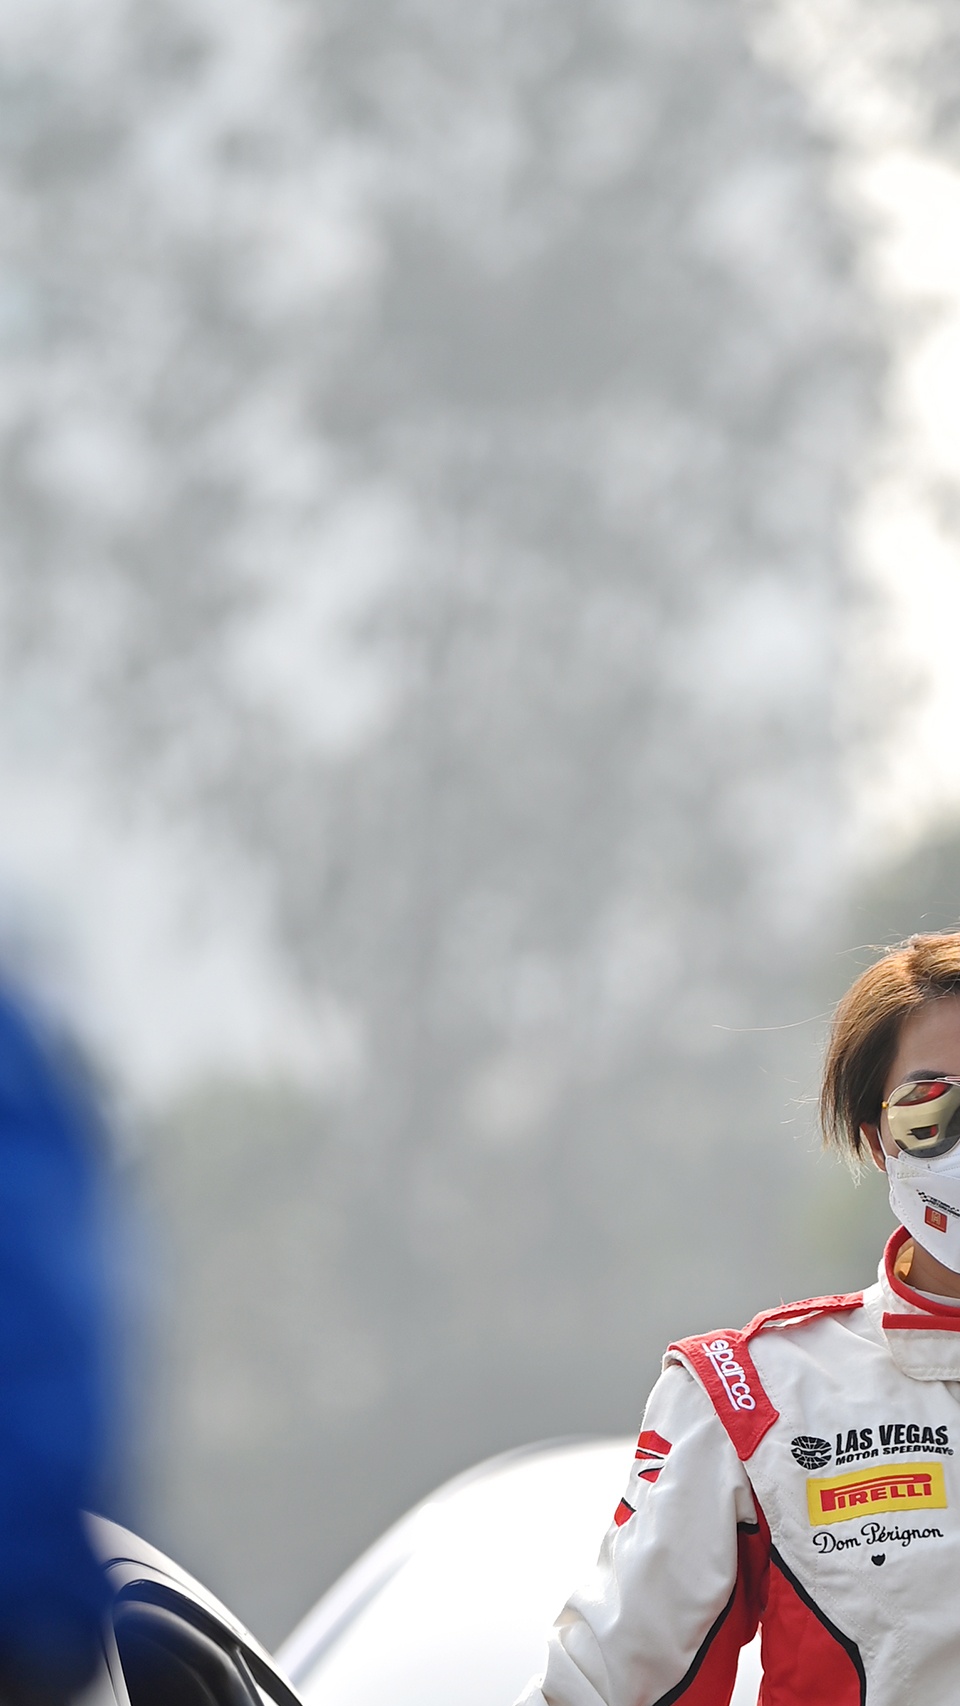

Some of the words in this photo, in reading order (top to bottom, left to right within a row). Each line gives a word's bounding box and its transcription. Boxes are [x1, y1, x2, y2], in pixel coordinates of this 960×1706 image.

[703, 1339, 756, 1411] sparco
[835, 1428, 873, 1456] LAS
[878, 1423, 949, 1447] VEGAS
[835, 1450, 879, 1466] MOTOR
[882, 1444, 950, 1457] SPEEDWAY
[820, 1473, 932, 1512] PIRELLI
[812, 1531, 862, 1554] Dom
[860, 1521, 944, 1547] Pérignon
